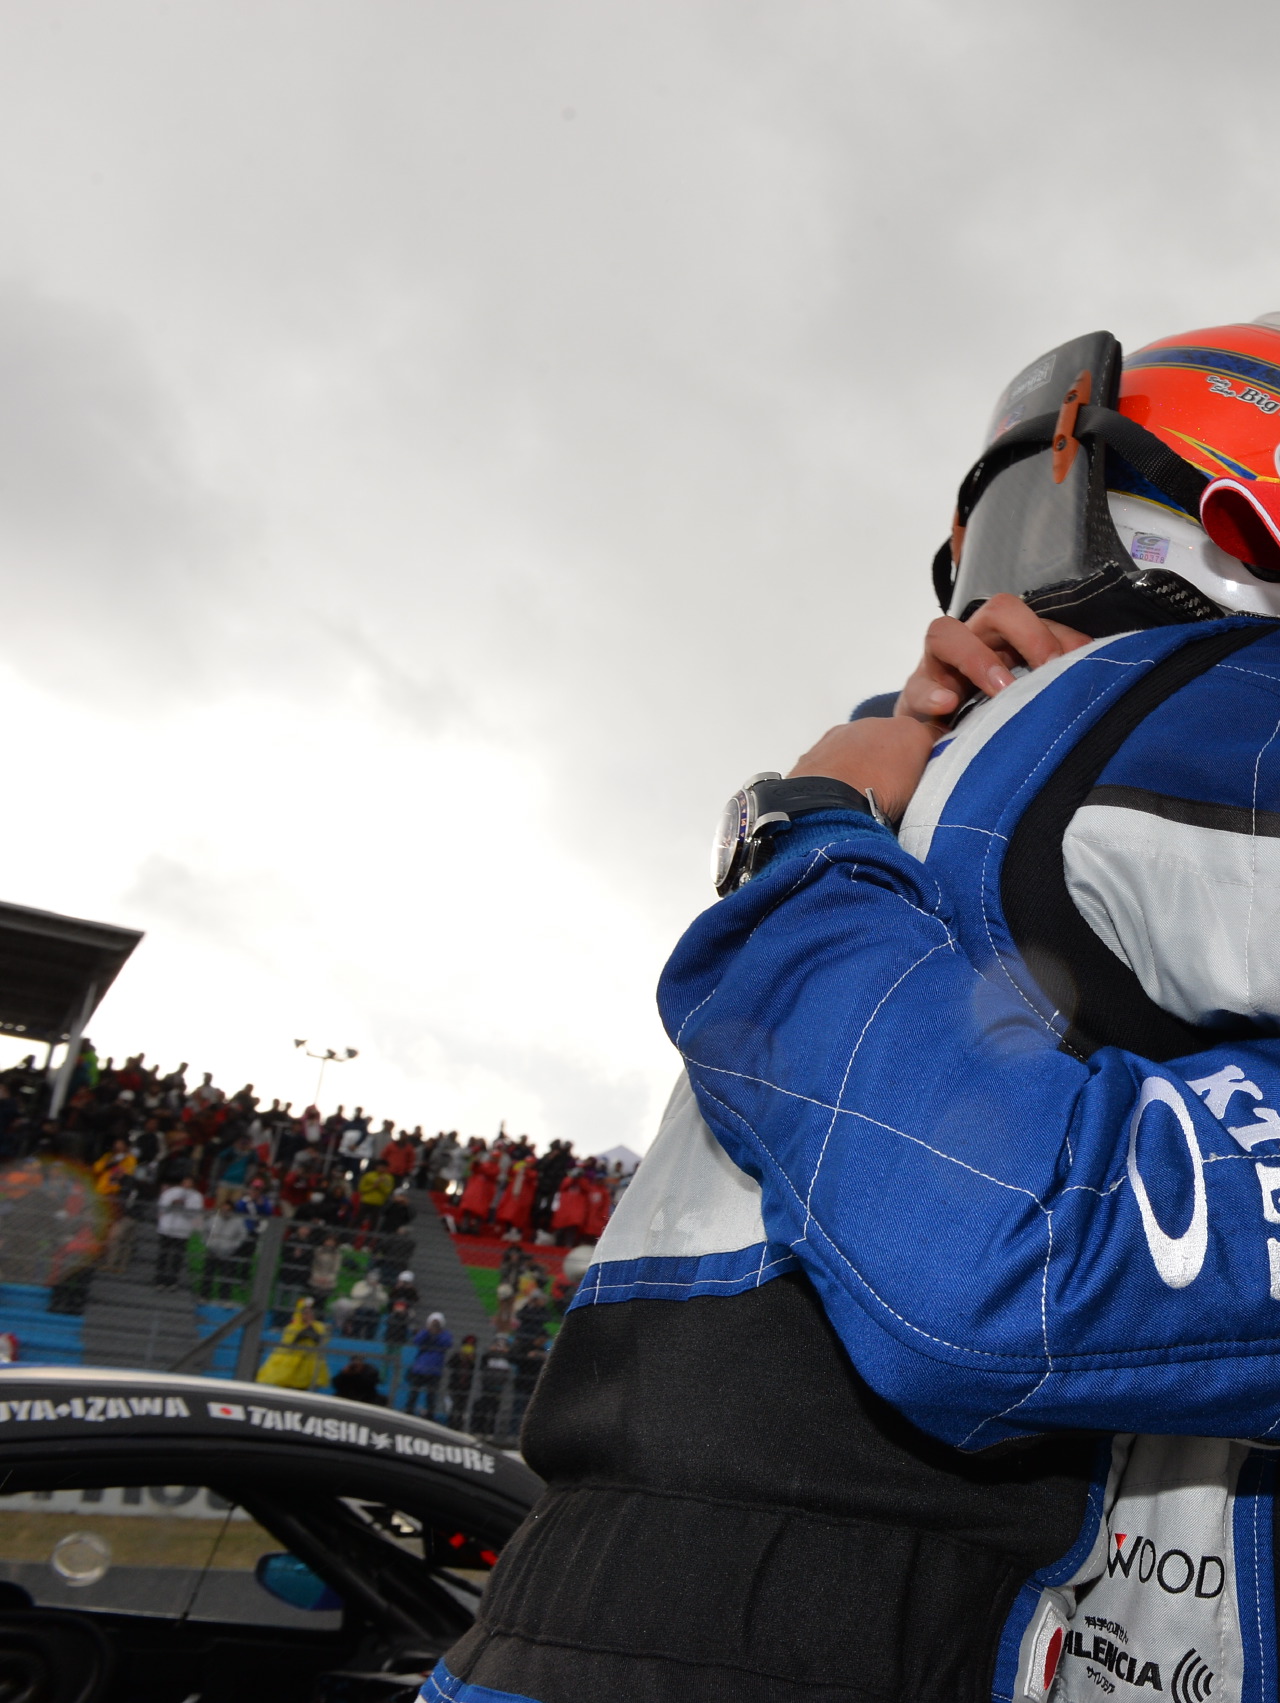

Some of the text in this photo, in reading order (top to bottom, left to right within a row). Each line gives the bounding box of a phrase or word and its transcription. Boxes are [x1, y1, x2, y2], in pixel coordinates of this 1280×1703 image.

[70, 1396, 191, 1422] IZAWA
[247, 1405, 496, 1475] TAKASHI KOGURE
